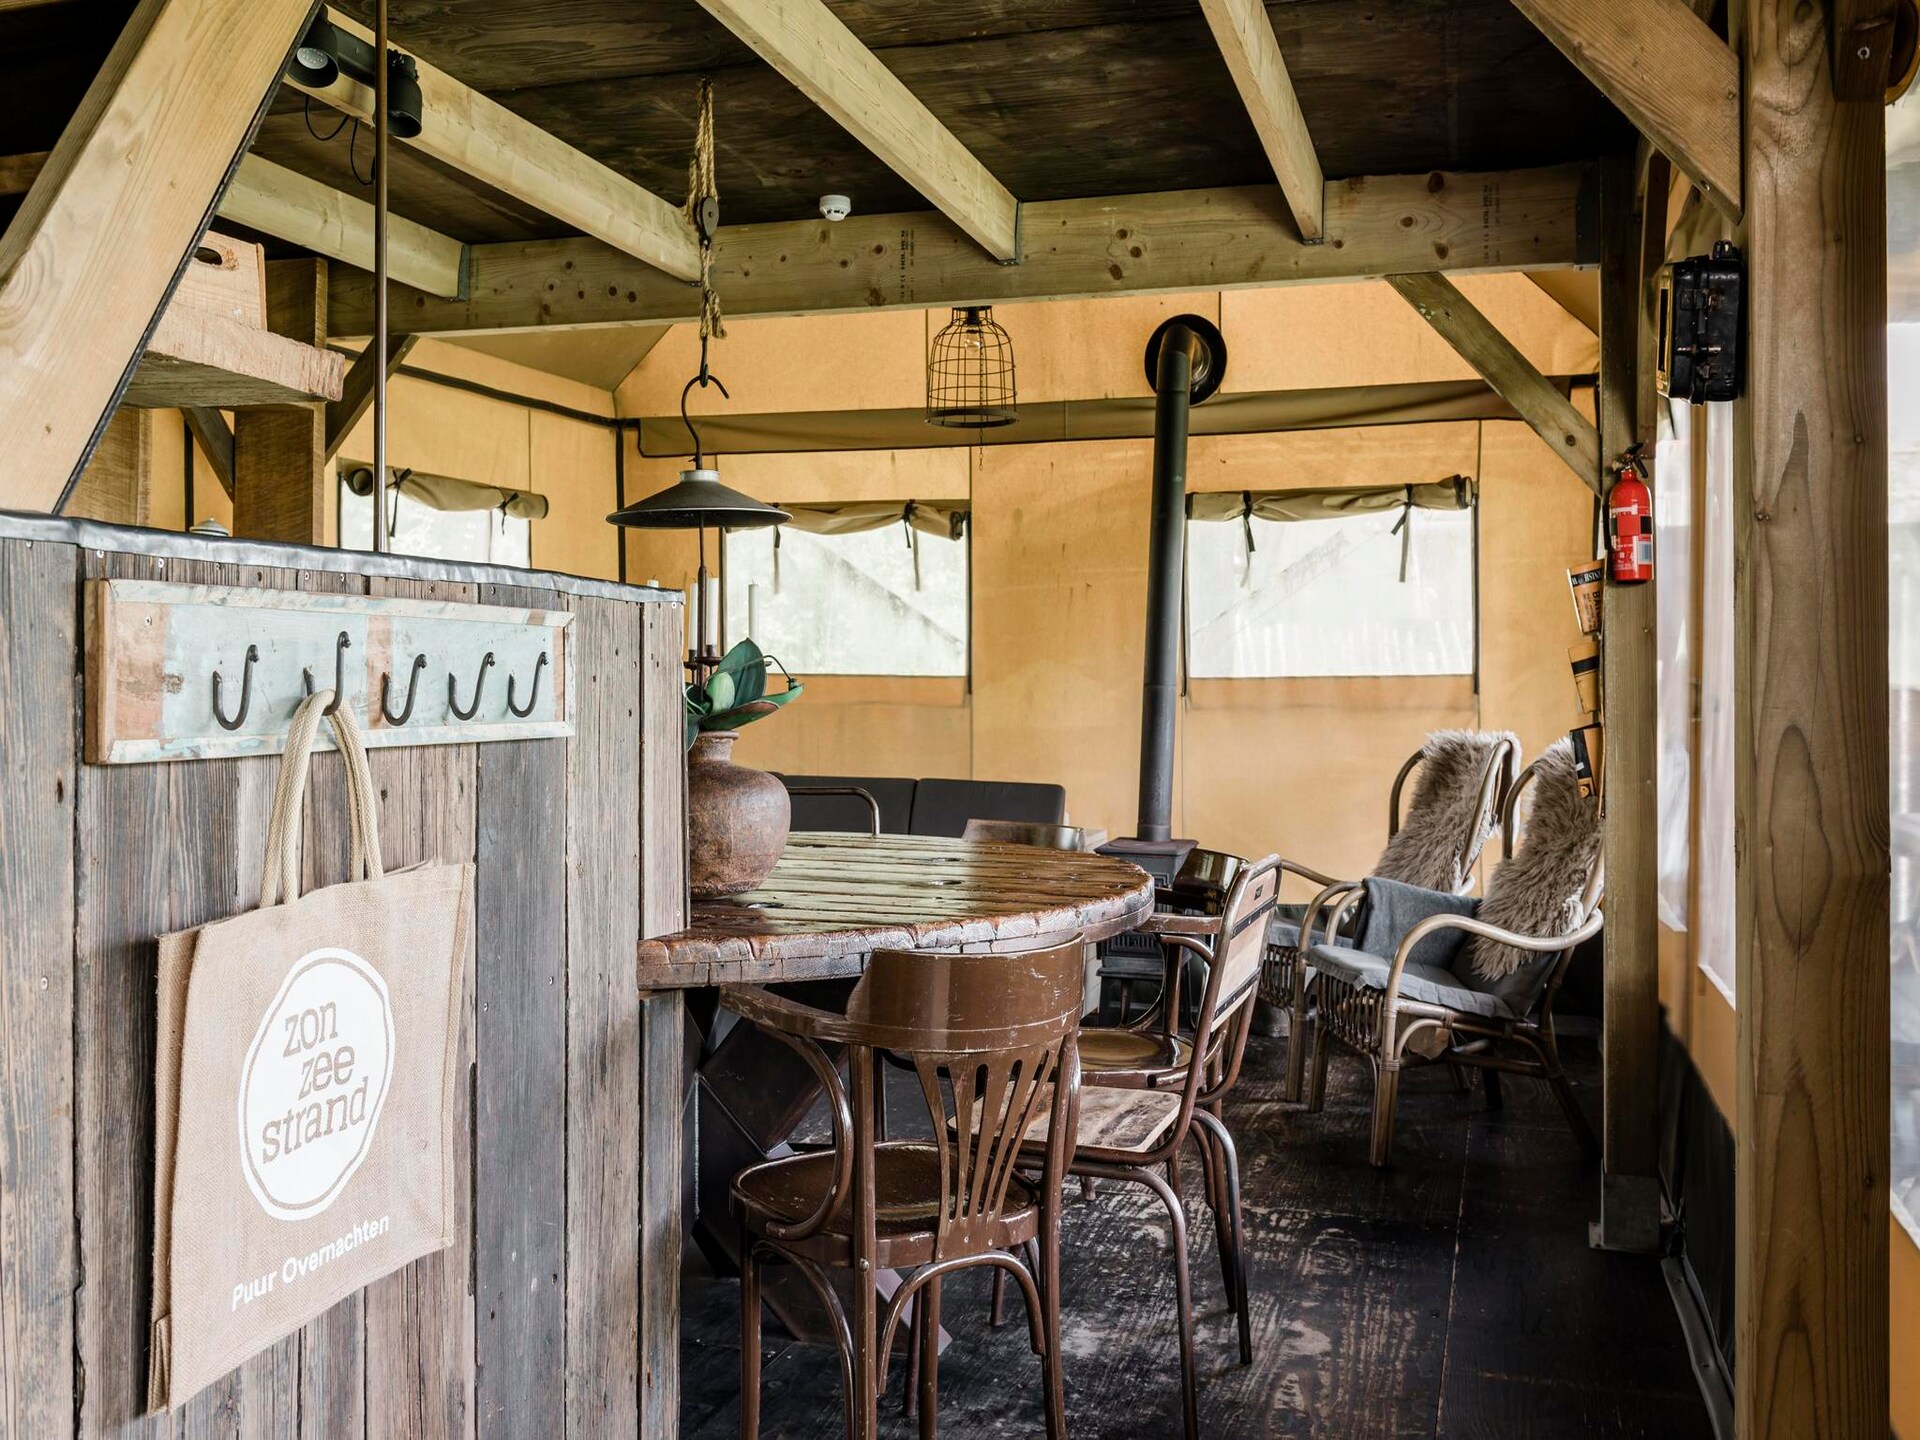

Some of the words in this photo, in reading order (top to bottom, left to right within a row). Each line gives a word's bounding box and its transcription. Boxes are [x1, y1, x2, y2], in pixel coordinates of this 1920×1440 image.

[283, 1001, 338, 1057] zon
[298, 1045, 355, 1101] zee
[262, 1076, 369, 1165] strand
[231, 1271, 278, 1312] Puur
[282, 1215, 390, 1284] Overnachten
